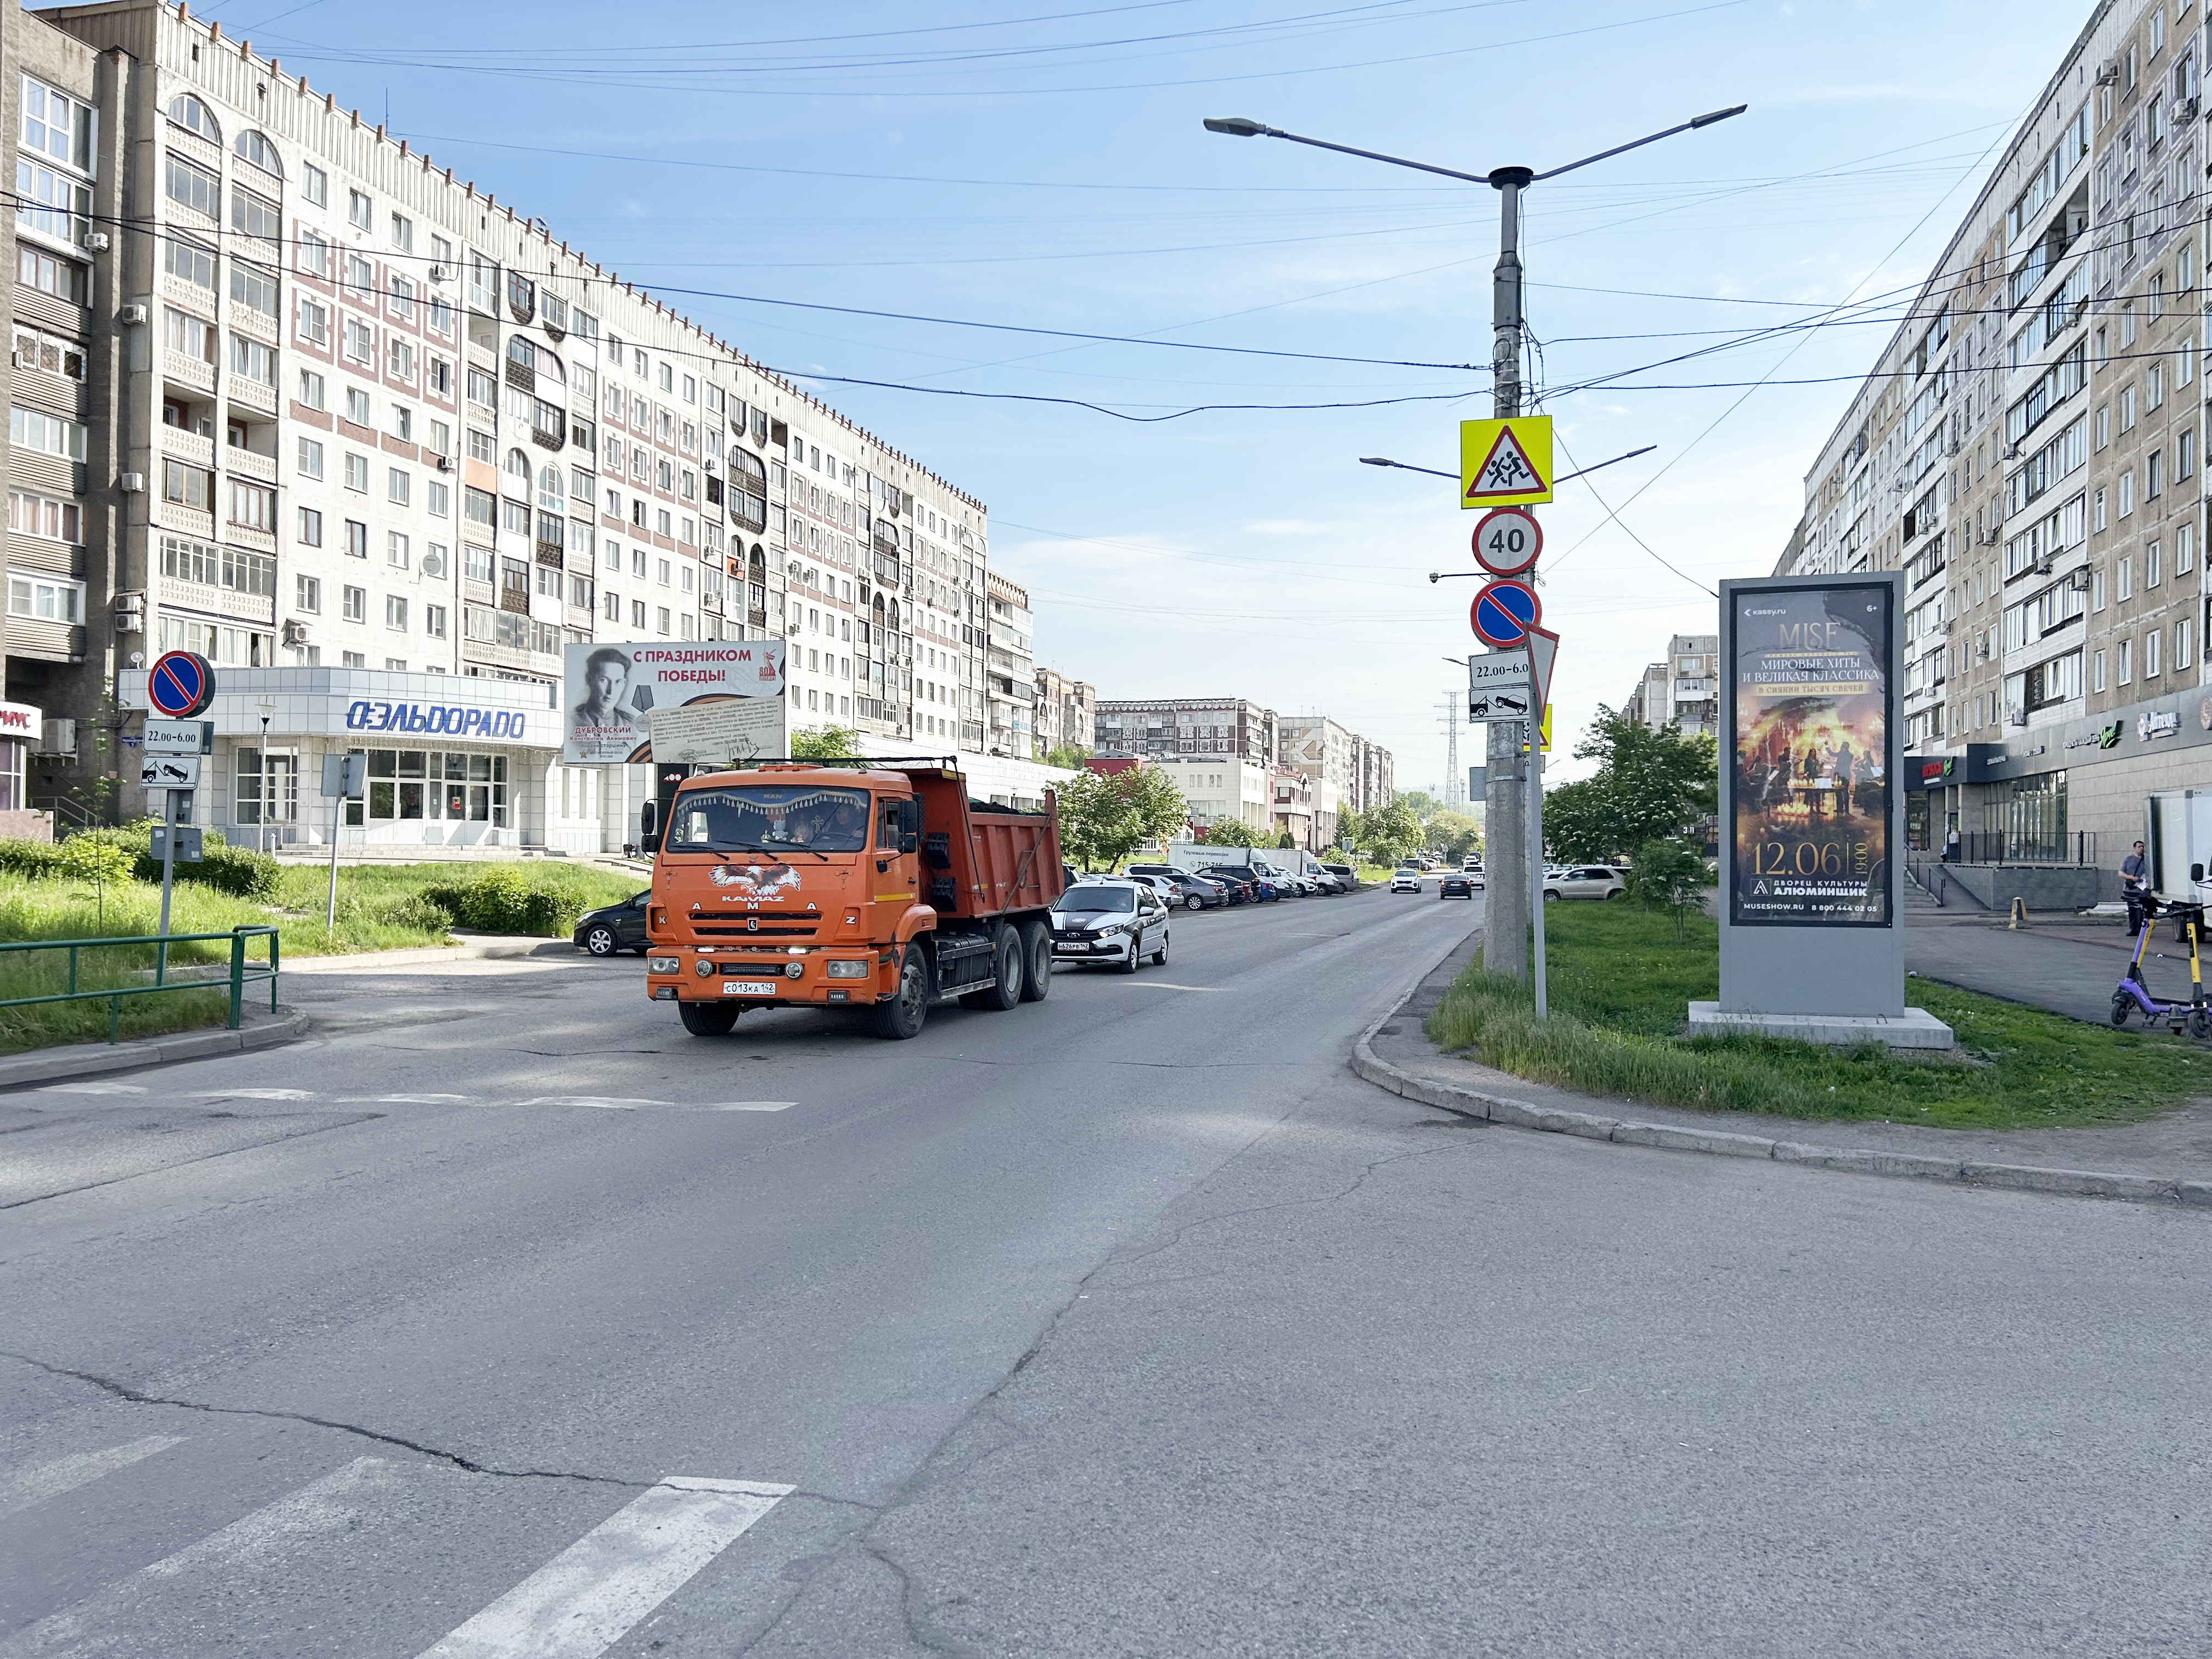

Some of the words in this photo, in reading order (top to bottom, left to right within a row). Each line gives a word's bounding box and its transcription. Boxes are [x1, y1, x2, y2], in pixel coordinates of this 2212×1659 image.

[1489, 529, 1525, 553] 40
[1753, 608, 1786, 617] kassy.ru
[634, 651, 642, 663] С
[645, 649, 752, 663] ПРАЗДНИКОМ
[1760, 658, 1824, 670] МИРОВЫЕ
[1827, 657, 1860, 668] ХИТЫ
[658, 669, 726, 684] ПОБЕДЫ!
[1477, 663, 1528, 678] 22.00-6.0
[1742, 673, 1751, 682] И
[1755, 671, 1809, 682] ВЕЛИКАЯ
[1813, 669, 1880, 681] КЛАССИКА
[1832, 684, 1864, 692] СВЕЧЕЙ
[575, 725, 631, 734] ДУБРОВСКИЙ
[148, 731, 196, 742] 22.00-6.00
[1750, 842, 1841, 876] 12.06
[1854, 842, 1867, 875] 19:00
[1774, 887, 1867, 896] АЛЮМИНЩИК
